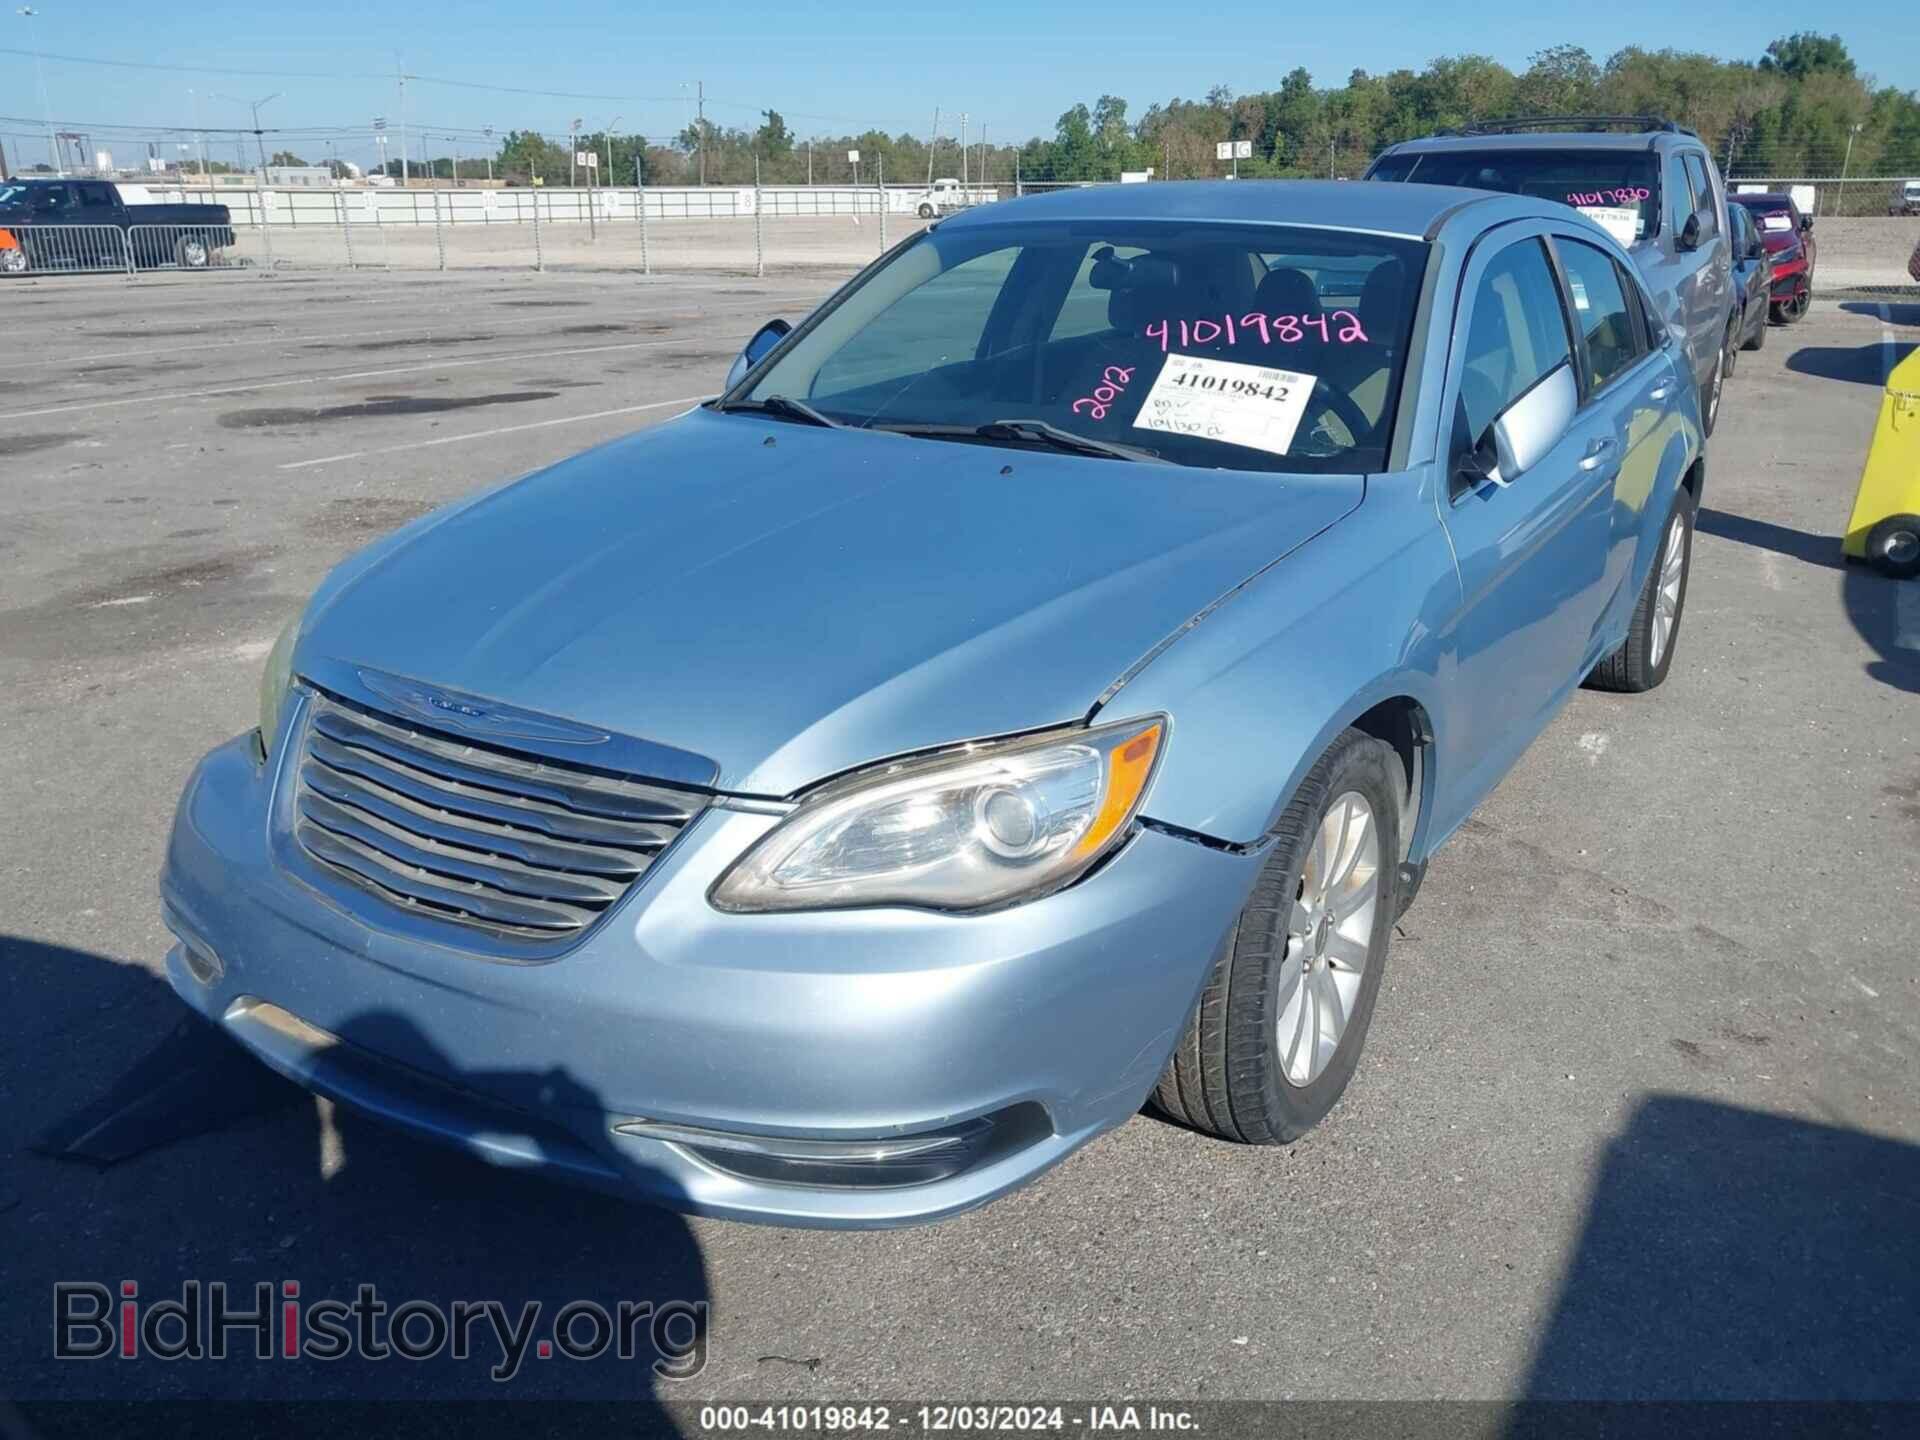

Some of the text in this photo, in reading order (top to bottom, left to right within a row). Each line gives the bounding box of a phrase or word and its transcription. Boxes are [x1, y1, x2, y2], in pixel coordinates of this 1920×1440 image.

[1239, 142, 1250, 157] G
[1567, 188, 1649, 205] 41017830
[1146, 311, 1368, 351] 41019842
[1072, 366, 1136, 419] 2012
[1172, 373, 1288, 402] 41019842
